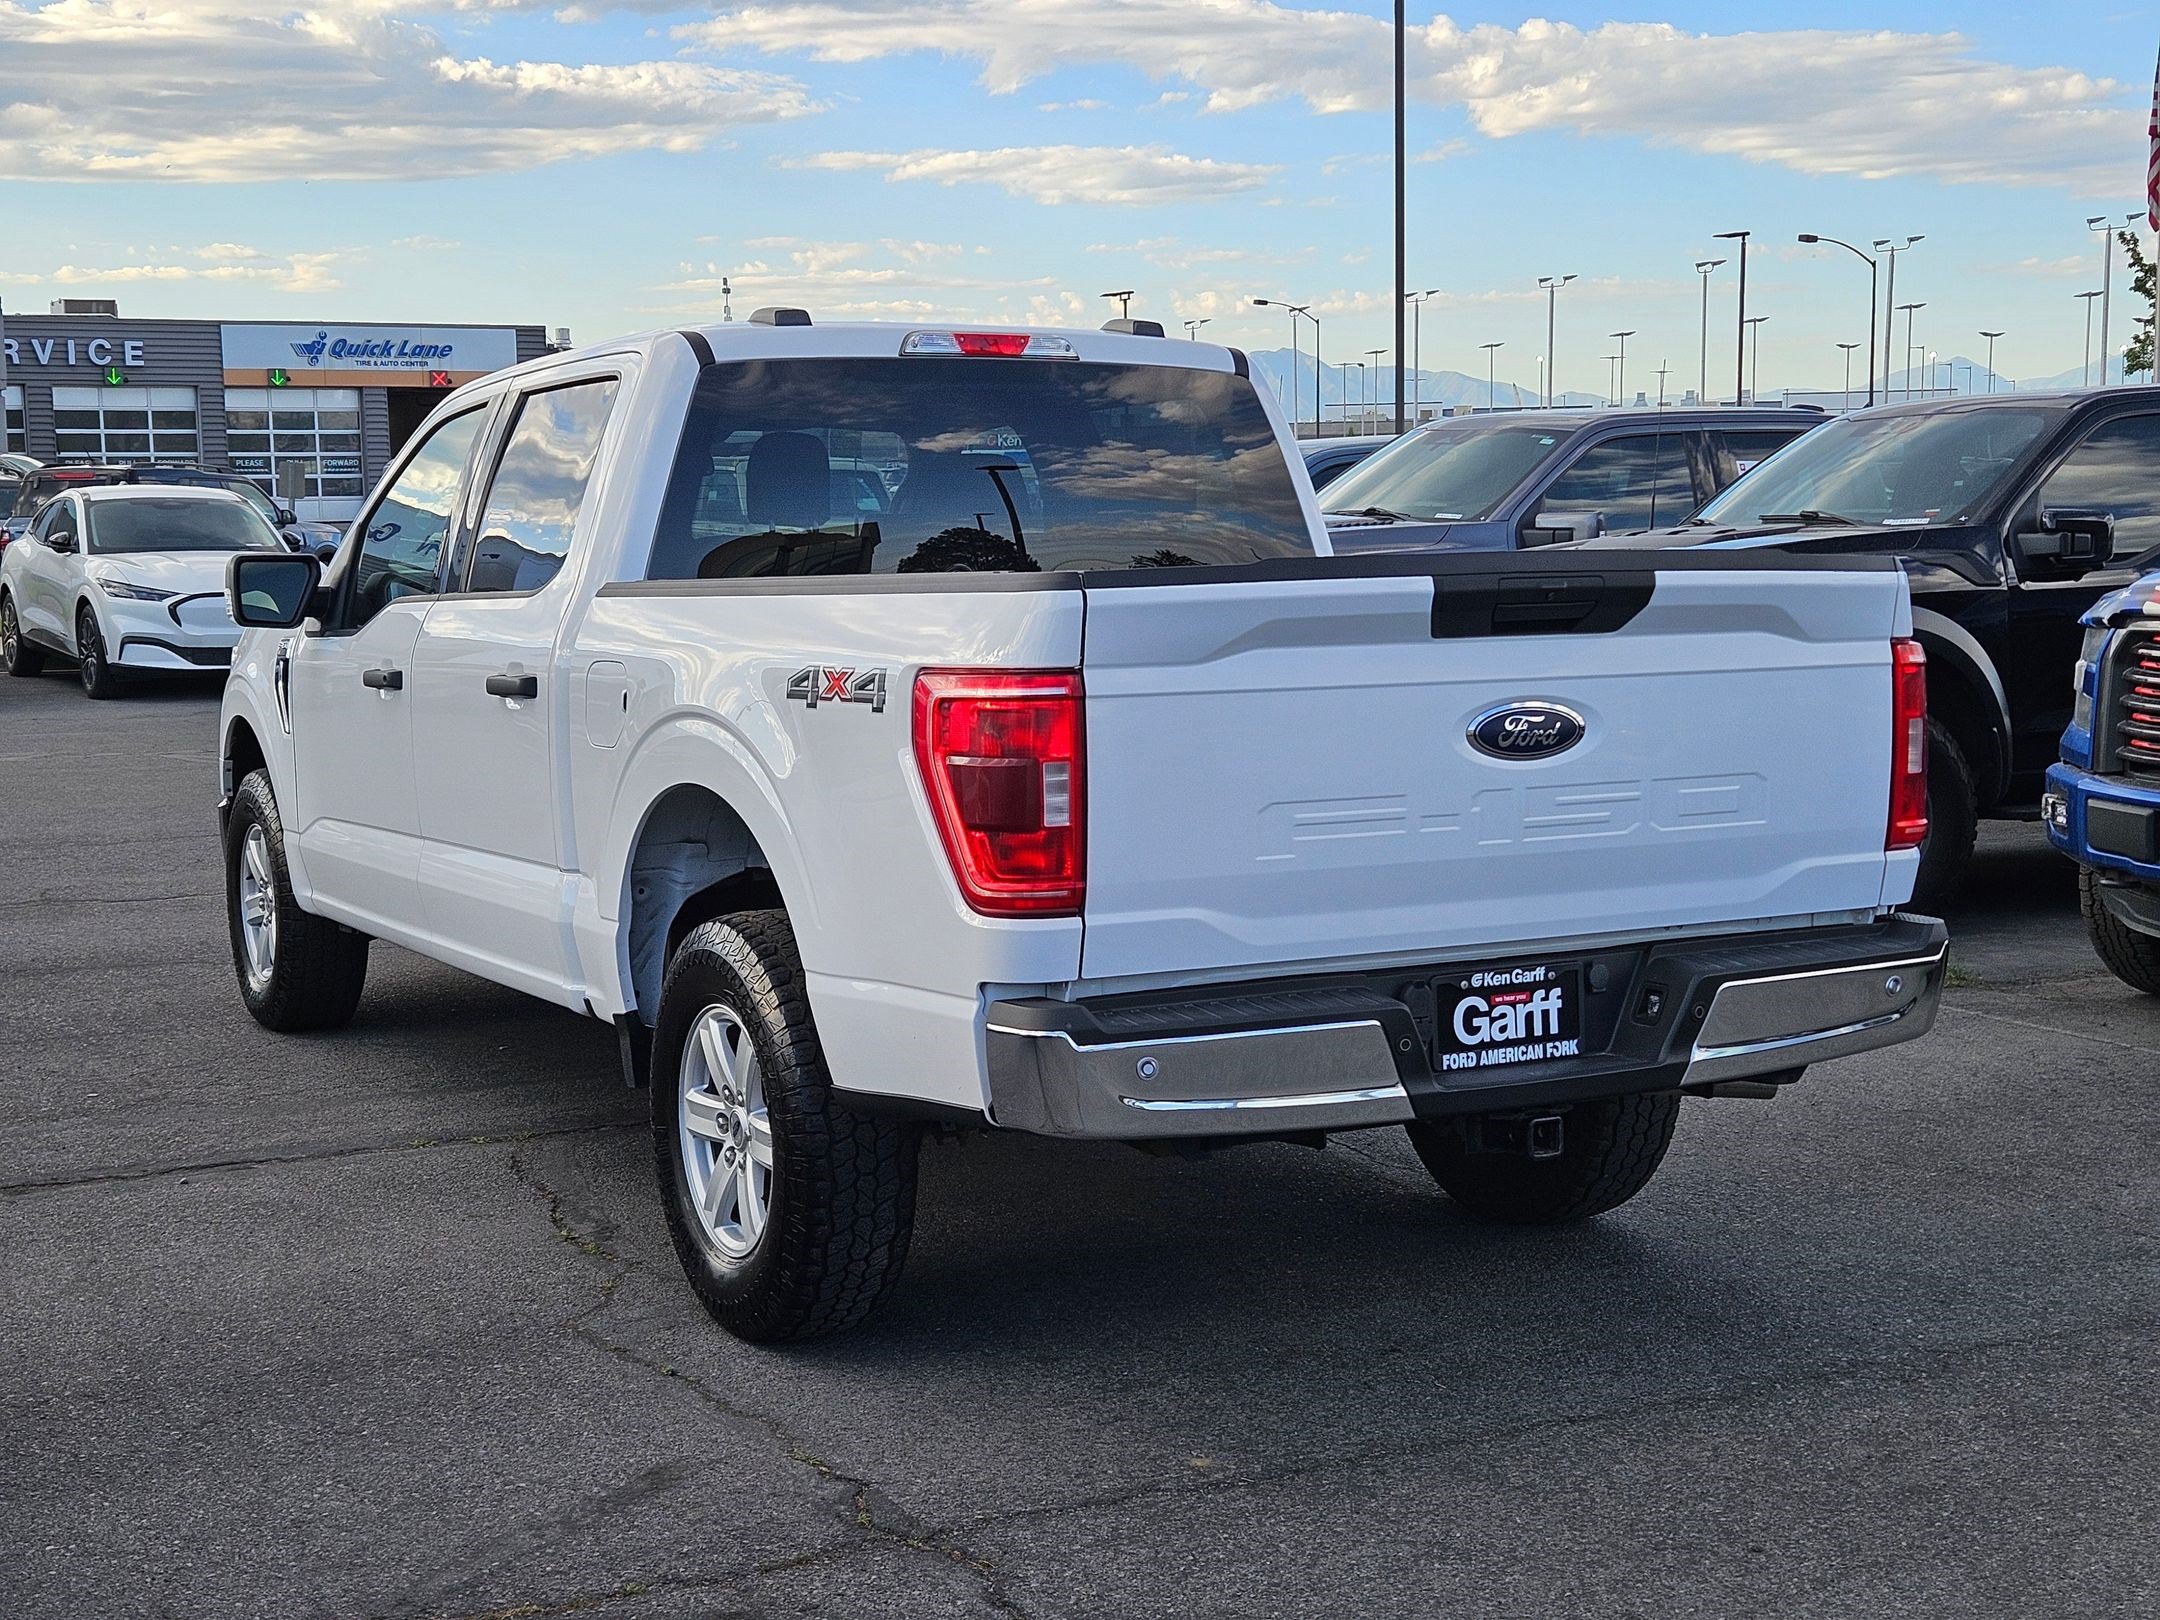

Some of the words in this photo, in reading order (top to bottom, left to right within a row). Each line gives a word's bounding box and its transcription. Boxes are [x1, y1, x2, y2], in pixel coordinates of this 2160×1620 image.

[328, 338, 392, 360] Quick
[394, 339, 453, 359] Lane
[400, 360, 429, 368] CENTER
[997, 433, 1022, 447] Ken
[235, 459, 264, 467] PLEASE
[323, 459, 359, 467] FORWARD
[1498, 714, 1561, 748] Ford
[1256, 772, 1768, 861] F-150
[1483, 971, 1511, 987] Ken
[1511, 966, 1546, 984] Garff
[1453, 987, 1563, 1046] Garff
[1442, 1053, 1477, 1071] FORD
[1479, 1043, 1544, 1066] AMERICAN
[1546, 1039, 1580, 1058] FORK
